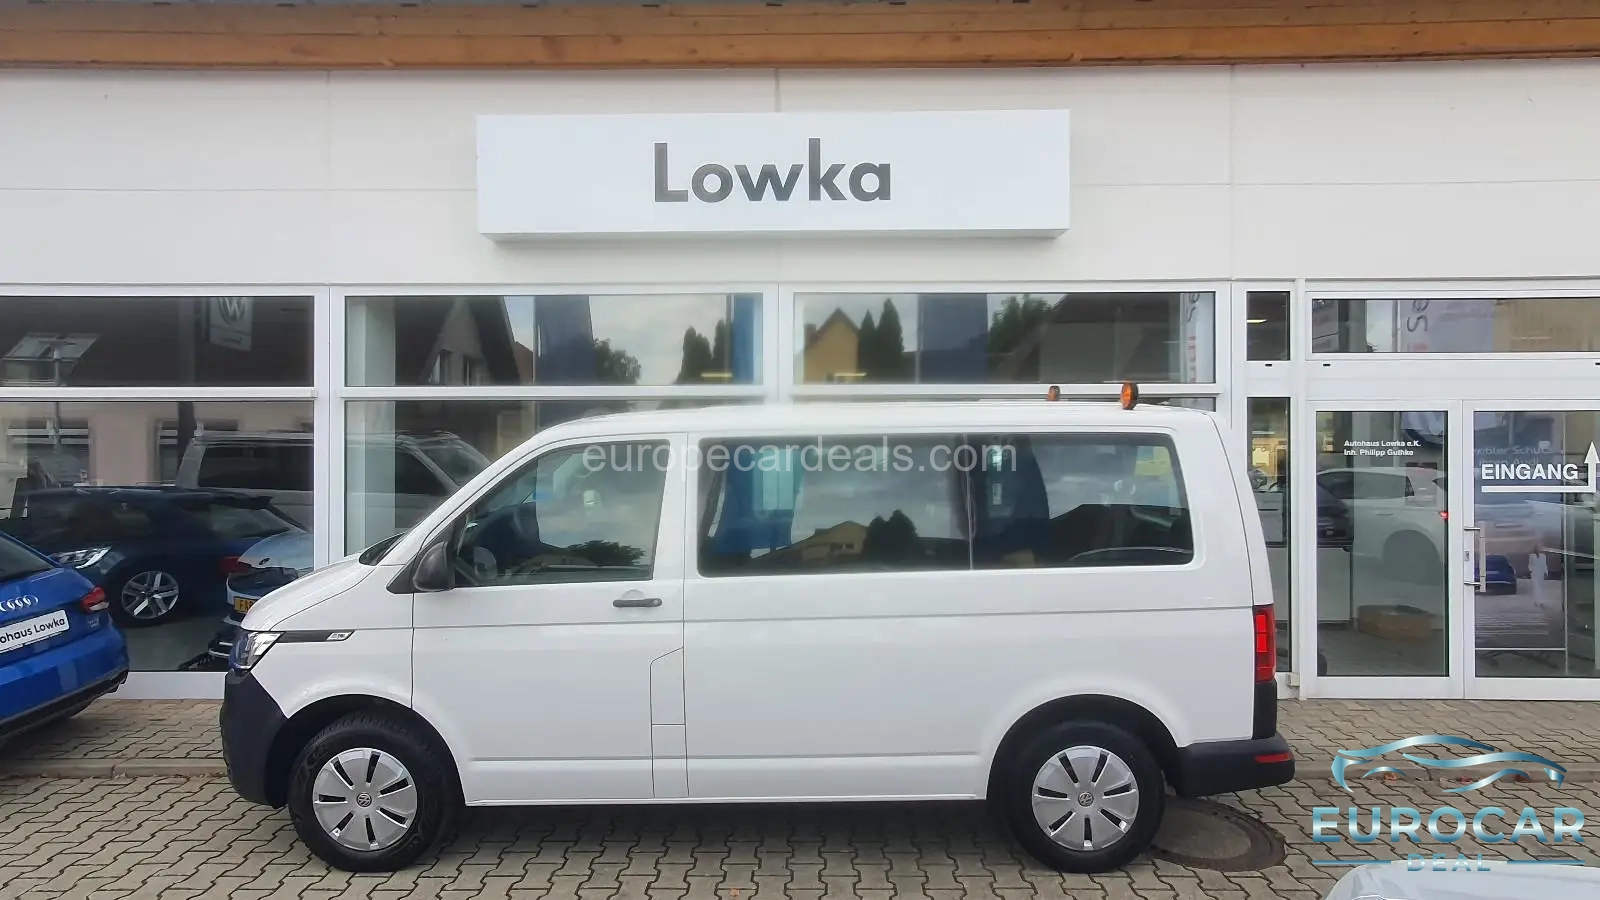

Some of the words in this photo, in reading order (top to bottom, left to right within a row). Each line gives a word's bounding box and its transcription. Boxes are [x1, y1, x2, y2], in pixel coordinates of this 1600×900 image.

[653, 138, 891, 203] Lowka
[1360, 449, 1385, 457] Philipp
[1481, 463, 1579, 480] EINGANG
[34, 617, 65, 633] Lowka
